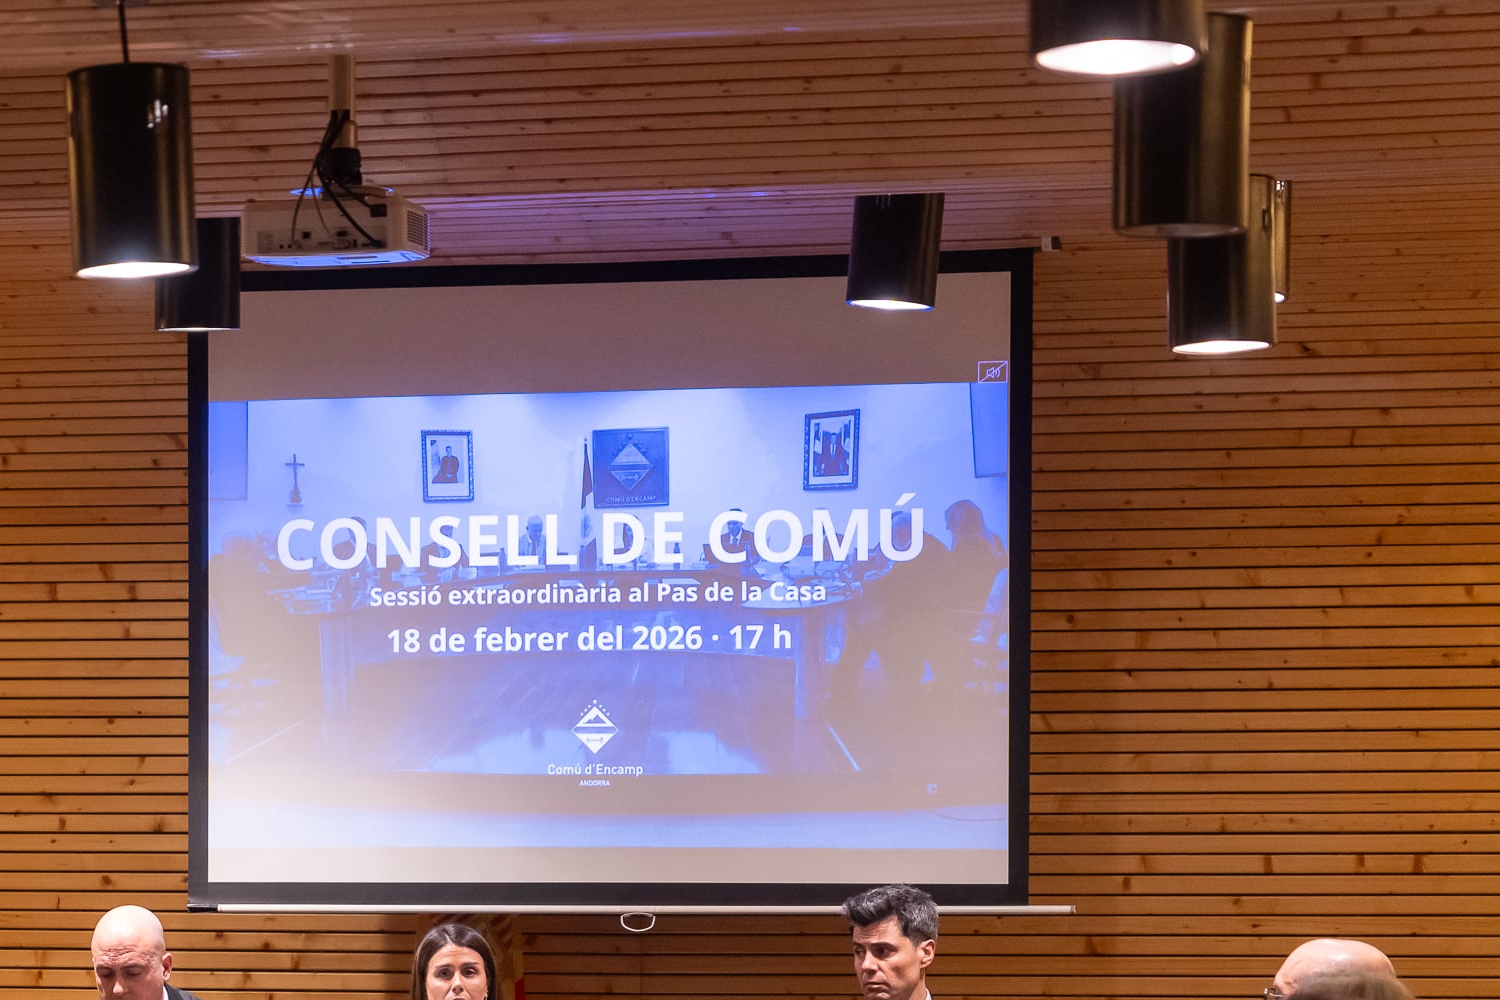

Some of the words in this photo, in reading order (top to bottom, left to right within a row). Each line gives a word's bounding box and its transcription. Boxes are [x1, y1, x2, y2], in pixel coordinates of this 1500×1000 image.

[277, 514, 577, 571] CONSELL
[602, 511, 685, 565] DE
[709, 493, 924, 564] COMÚ
[369, 585, 441, 607] Sessió
[448, 582, 621, 606] extraordinària
[628, 582, 649, 603] al
[657, 583, 698, 603] Pas
[704, 581, 734, 602] de
[741, 581, 762, 602] la
[769, 582, 826, 602] Casa
[387, 629, 421, 653] 18
[429, 627, 465, 653] de
[474, 626, 569, 652] febrer
[577, 625, 623, 651] del
[632, 625, 703, 651] 2026
[729, 624, 764, 650] 17
[773, 624, 792, 649] h
[547, 763, 582, 775] Comú
[585, 763, 644, 777] d'Encamp
